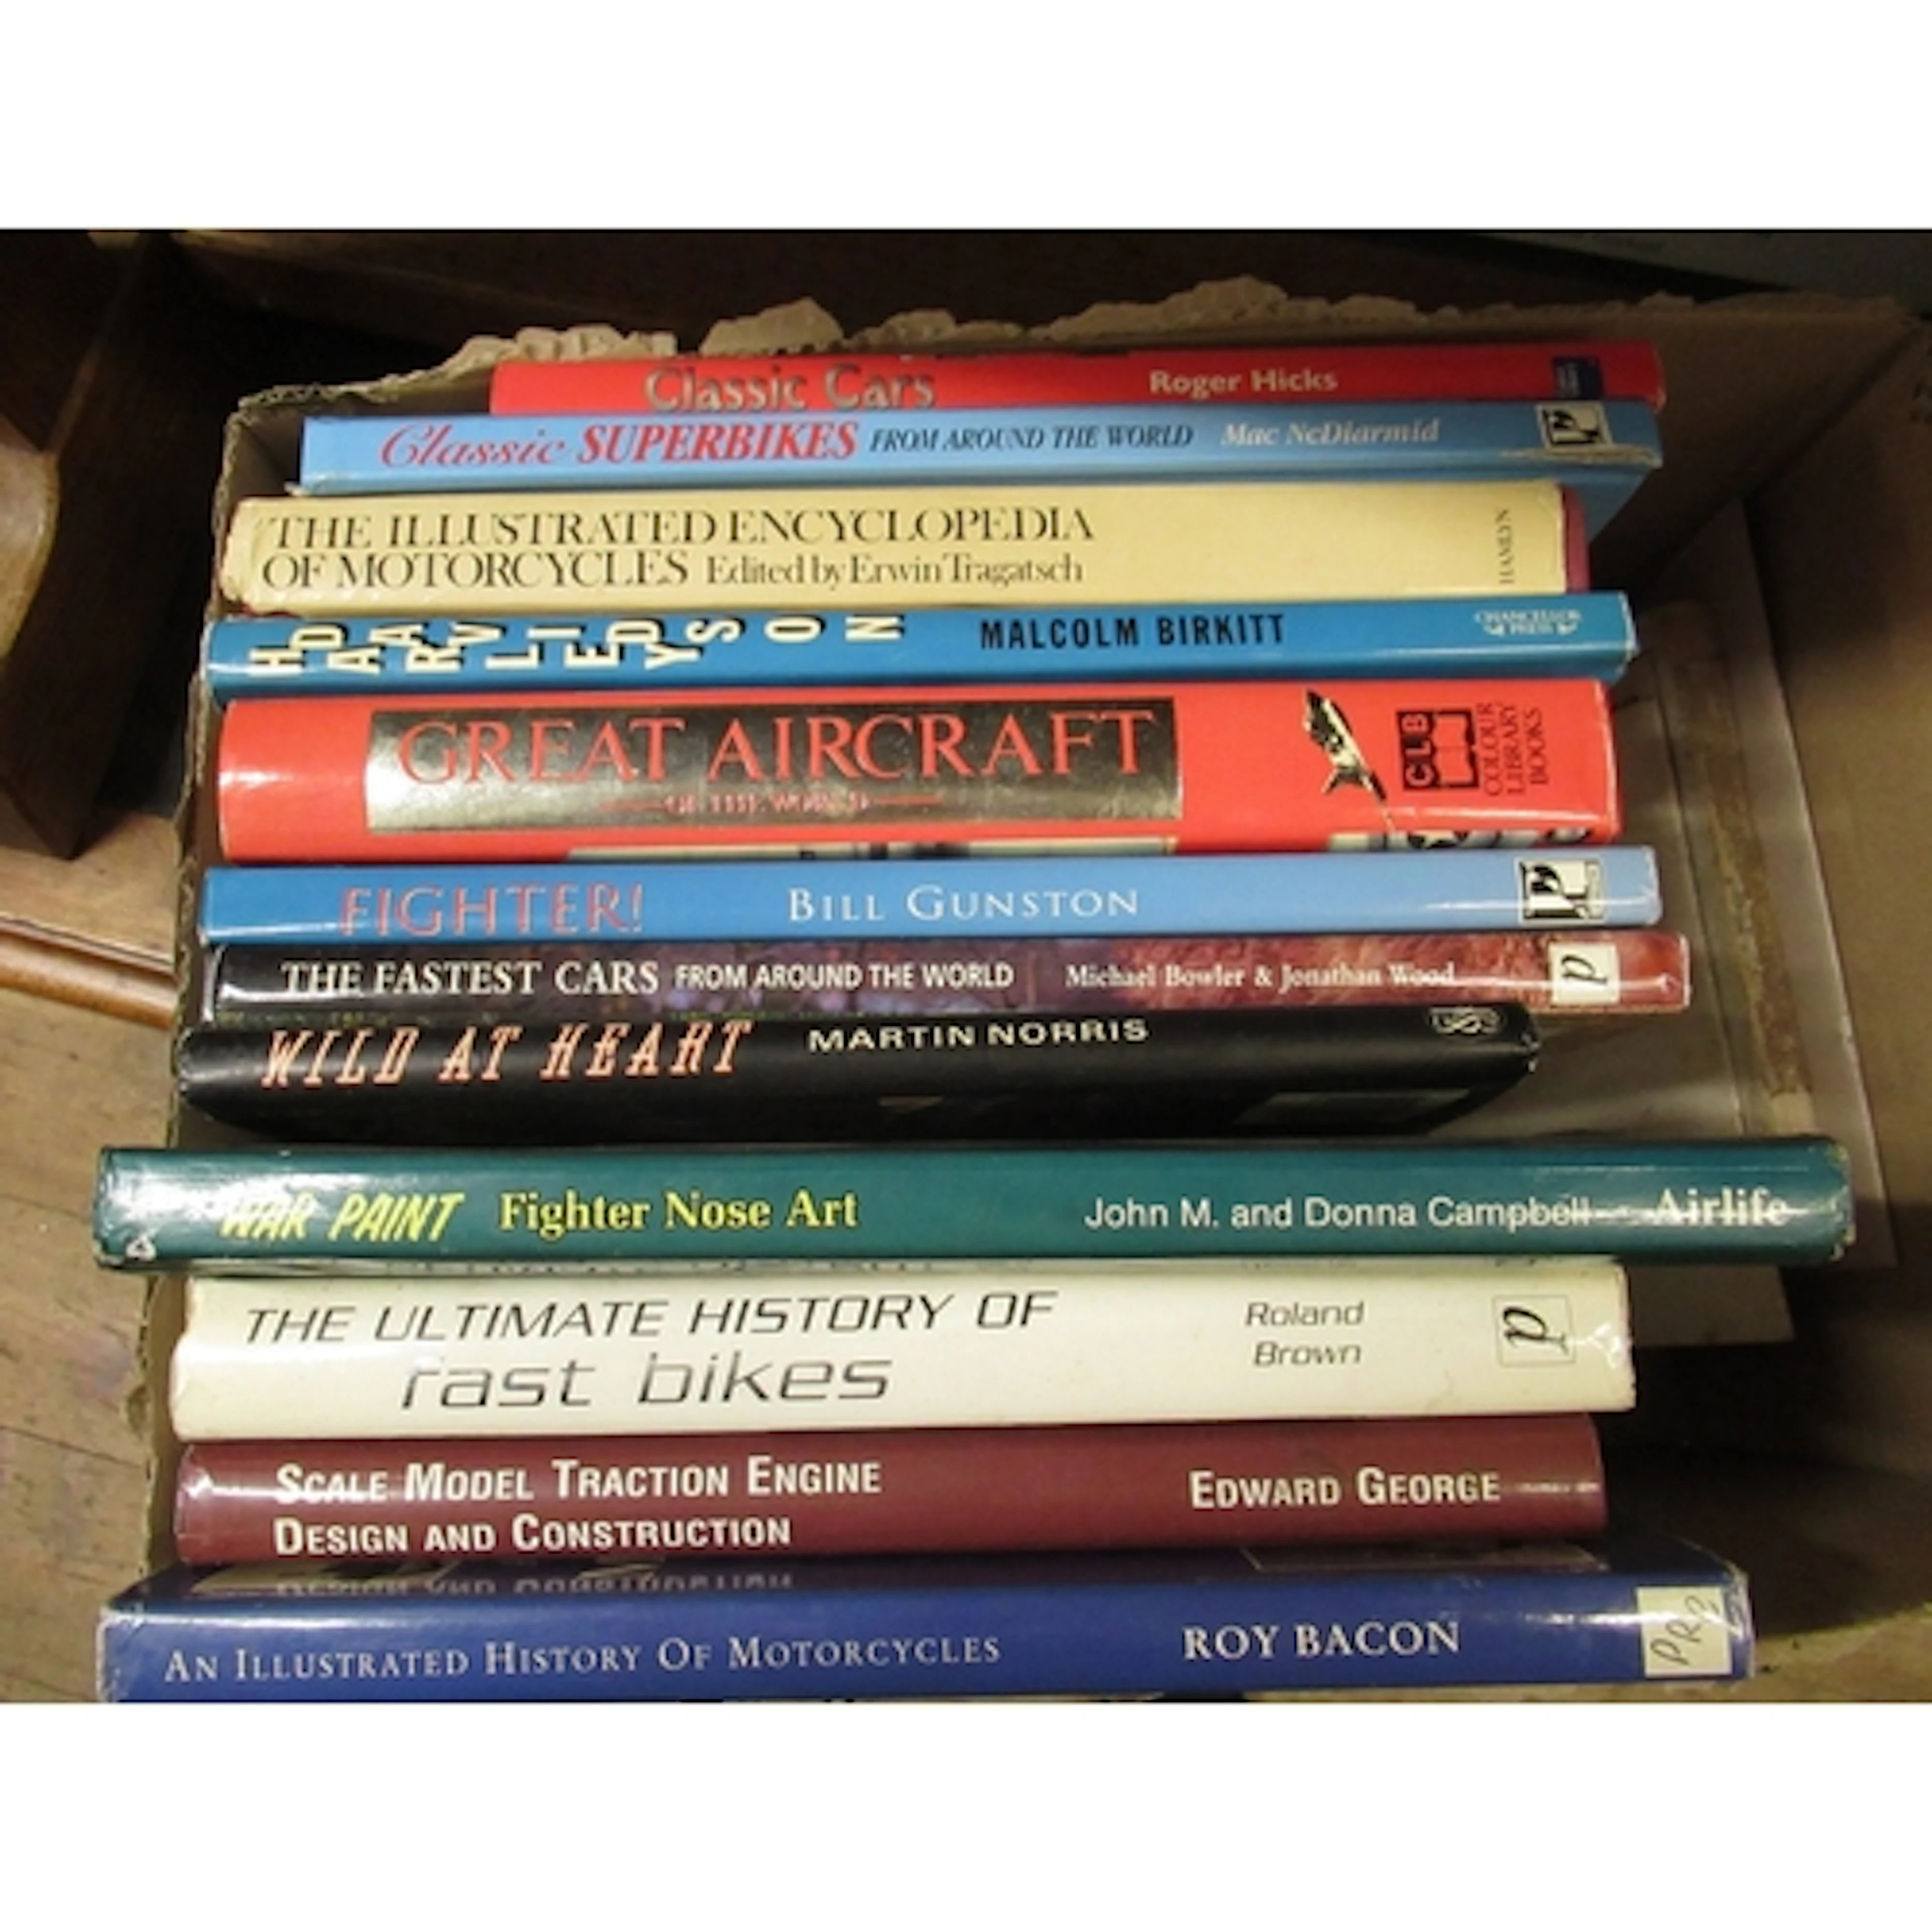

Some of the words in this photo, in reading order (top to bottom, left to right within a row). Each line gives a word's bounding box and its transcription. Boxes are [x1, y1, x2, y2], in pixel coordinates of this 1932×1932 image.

[644, 363, 808, 413] Classic
[825, 362, 936, 412] Cars
[1149, 369, 1243, 399] Roger
[1251, 367, 1338, 392] Hicks
[380, 424, 565, 467] Classic
[578, 421, 858, 464] SUPERBIKES
[870, 427, 939, 451] FROM
[943, 426, 1044, 450] AROUND
[1054, 424, 1099, 449] THE
[1108, 424, 1194, 448] WORLD
[1221, 421, 1278, 446] Mac
[272, 516, 372, 550] THE
[388, 510, 716, 547] ILLUSTRATED
[730, 506, 1094, 544] ENCYCLOPEDIA
[262, 553, 327, 589] OF
[338, 549, 689, 588] MOTORCYCLES
[707, 552, 804, 585] Edited
[811, 552, 847, 590] by
[851, 552, 942, 583] Erwin
[943, 551, 1084, 587] Tragatsch
[981, 618, 1139, 650] MALCOLM
[1158, 614, 1284, 646] BIRKITT
[398, 718, 685, 784] GREAT
[709, 710, 1156, 781] AIRCRAFT
[1403, 712, 1433, 786] CLB
[1477, 703, 1503, 796] COLOUR
[1499, 702, 1525, 795] LIBRARY
[1522, 707, 1549, 786] BOOKS
[339, 882, 644, 936] FIGHTER!
[281, 961, 361, 996] THE
[373, 960, 542, 995] FASTEST
[554, 960, 660, 995] CARS
[675, 964, 747, 989] FROM
[755, 964, 863, 989] AROUND
[869, 963, 914, 988] THE
[922, 963, 1014, 988] WORLD
[1066, 964, 1157, 988] Michael
[1165, 964, 1245, 988] Bowler
[1254, 965, 1274, 988] &
[1279, 963, 1382, 993] Jonathan
[1387, 963, 1456, 988] Wood
[260, 1025, 421, 1088] WILD
[438, 1025, 524, 1083] AT
[539, 1021, 755, 1081] HEART
[807, 1024, 975, 1054] MARTIN
[987, 1018, 1150, 1048] NORRIS
[219, 1191, 313, 1239] WAR
[327, 1192, 465, 1242] PAINT
[499, 1189, 651, 1241] Fighter
[665, 1191, 772, 1230] Nose
[786, 1188, 859, 1228] Art
[1084, 1197, 1169, 1229] John
[1181, 1197, 1220, 1228] M.
[1230, 1197, 1293, 1228] and
[1305, 1196, 1417, 1229] Donna
[1427, 1195, 1590, 1234] Campbell
[1653, 1187, 1789, 1228] Airlife
[247, 1305, 356, 1344] THE
[373, 1301, 669, 1342] ULTIMATE
[689, 1293, 955, 1335] HISTORY
[976, 1290, 1059, 1331] OF
[1245, 1300, 1365, 1328] Roland
[1253, 1340, 1362, 1367] Brown
[637, 1350, 893, 1405] bikes
[273, 1462, 388, 1502] SCALE
[405, 1462, 534, 1502] MODEL
[552, 1458, 729, 1498] TRACTION
[748, 1454, 882, 1495] ENGINE
[1188, 1470, 1341, 1509] EDWARD
[1357, 1466, 1501, 1506] GEORGE
[274, 1516, 408, 1556] DESIGN
[424, 1523, 496, 1553] AND
[512, 1512, 791, 1551] CONSTRUCTION
[1182, 1624, 1280, 1660] ROY
[1294, 1621, 1460, 1657] BACON
